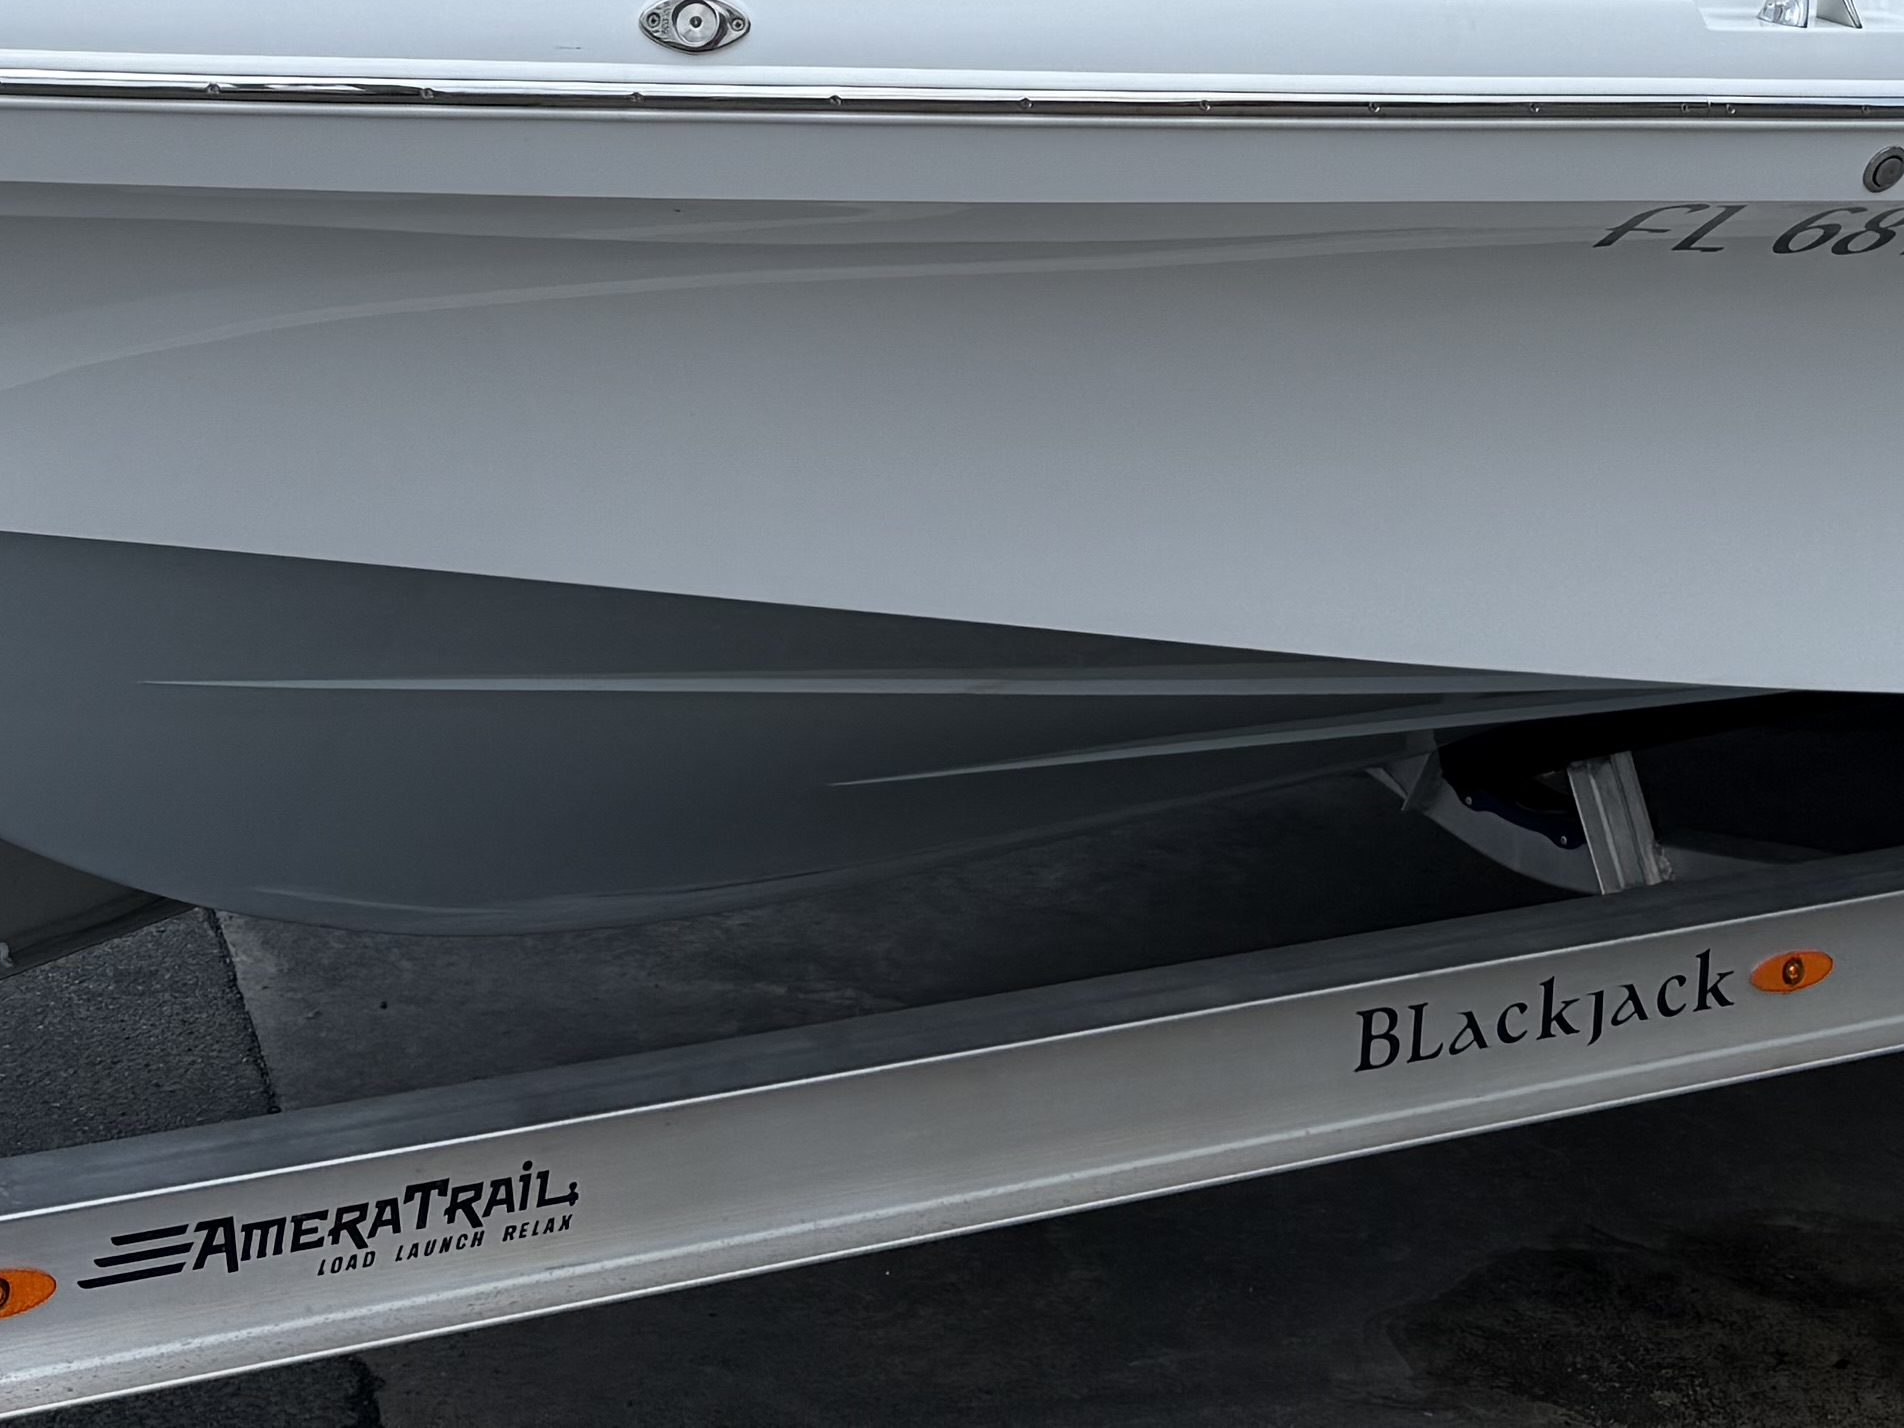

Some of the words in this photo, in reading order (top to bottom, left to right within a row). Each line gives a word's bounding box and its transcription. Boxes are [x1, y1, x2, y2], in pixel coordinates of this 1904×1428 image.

[1592, 203, 1750, 254] FL
[317, 1248, 378, 1278] LOAD
[394, 1226, 486, 1264] LAUNCH
[501, 1211, 574, 1244] RELAX
